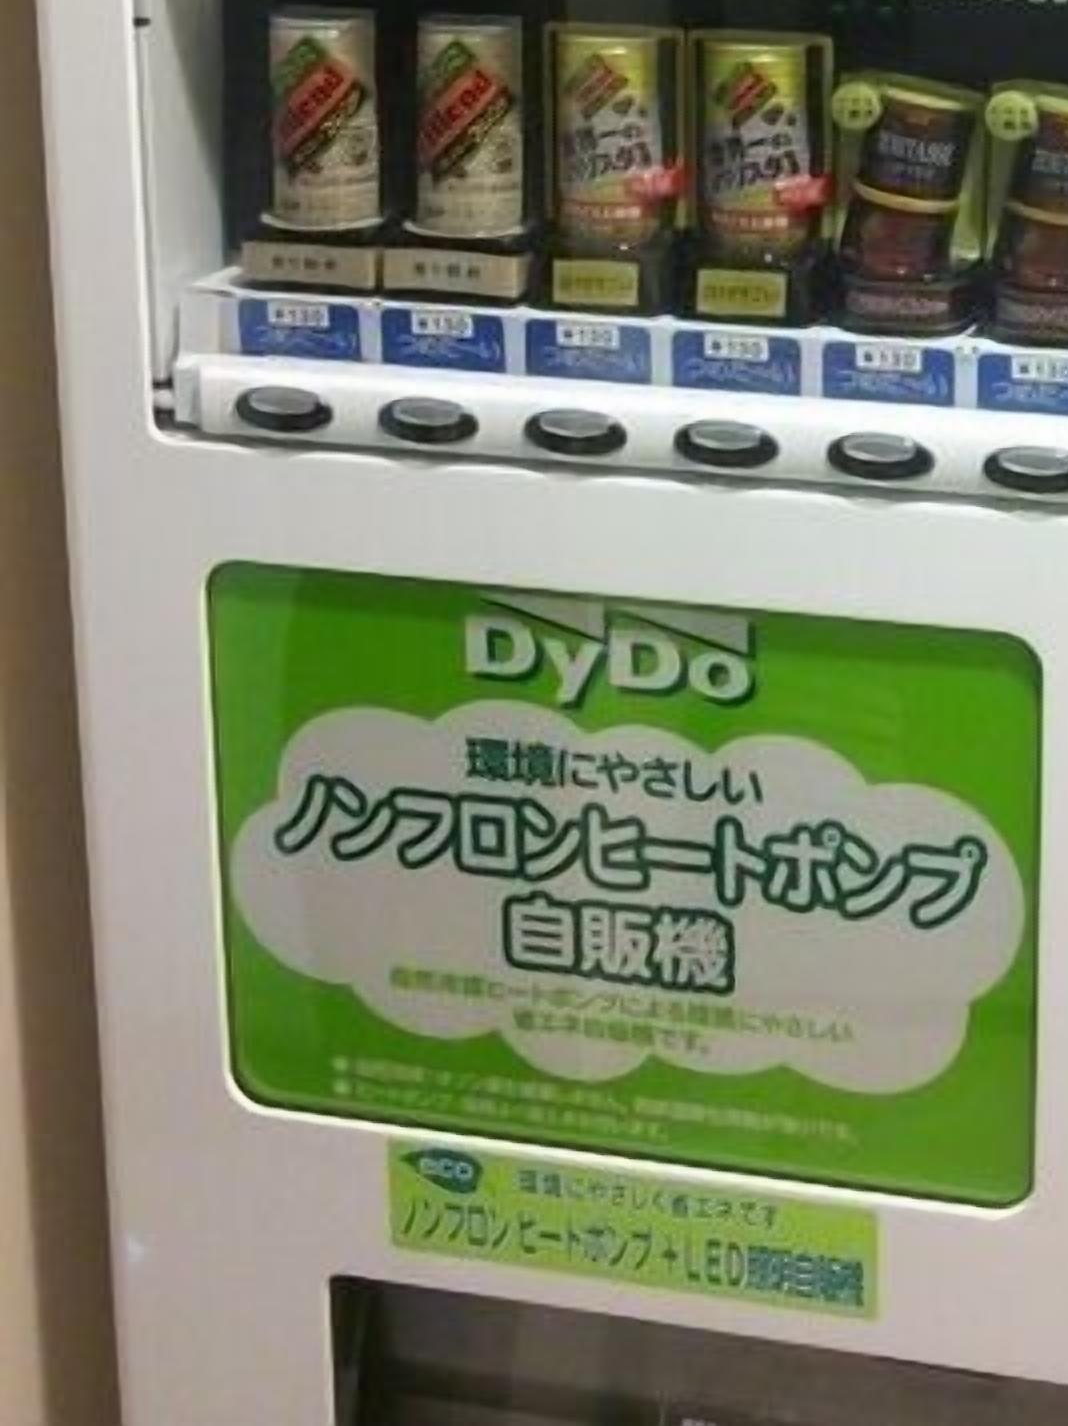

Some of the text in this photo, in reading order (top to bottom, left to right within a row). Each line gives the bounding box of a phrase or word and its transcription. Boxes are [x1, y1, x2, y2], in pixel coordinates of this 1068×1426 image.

[464, 614, 757, 708] DyDo
[466, 736, 764, 807] 環境にやさしい
[275, 775, 988, 929] ノンフロンヒートポンプ
[502, 892, 736, 994] 自販機
